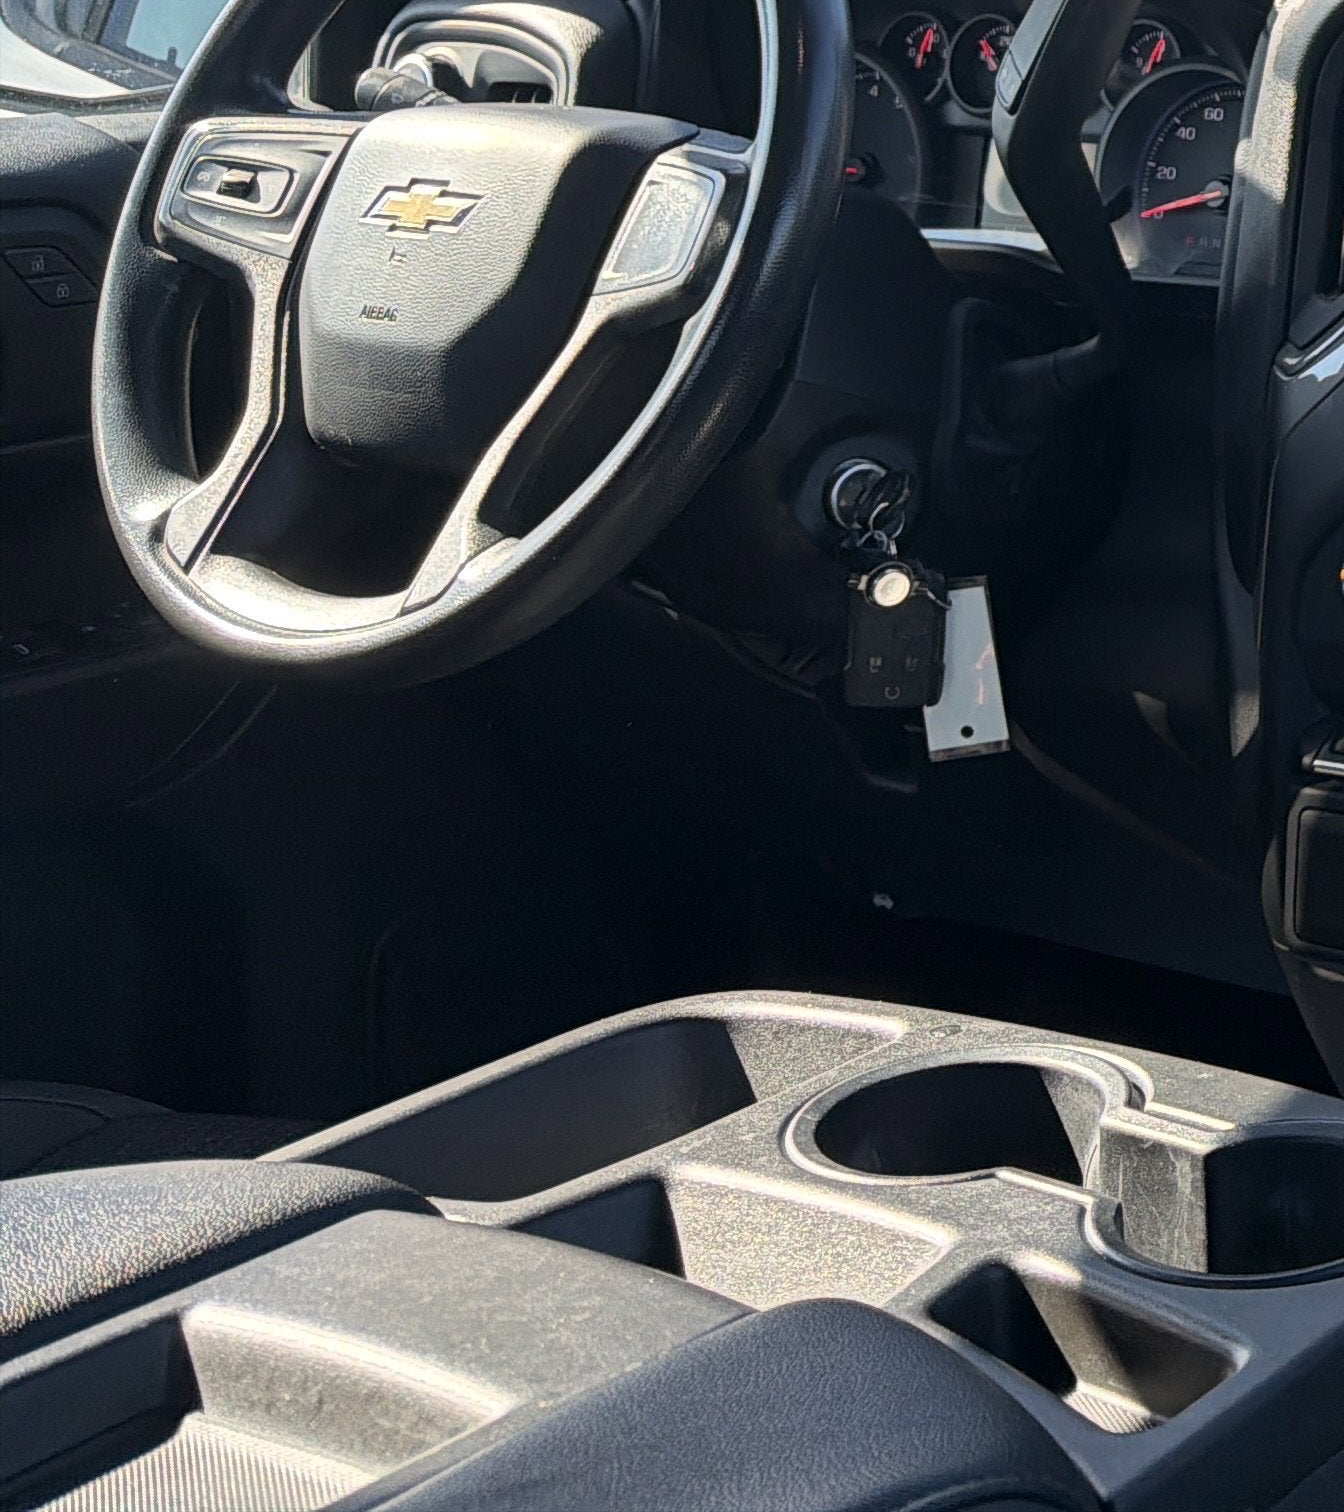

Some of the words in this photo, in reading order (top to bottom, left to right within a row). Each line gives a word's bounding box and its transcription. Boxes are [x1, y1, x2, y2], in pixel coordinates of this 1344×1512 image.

[1204, 107, 1224, 121] 60
[1176, 127, 1196, 141] 40
[1155, 166, 1177, 180] 20
